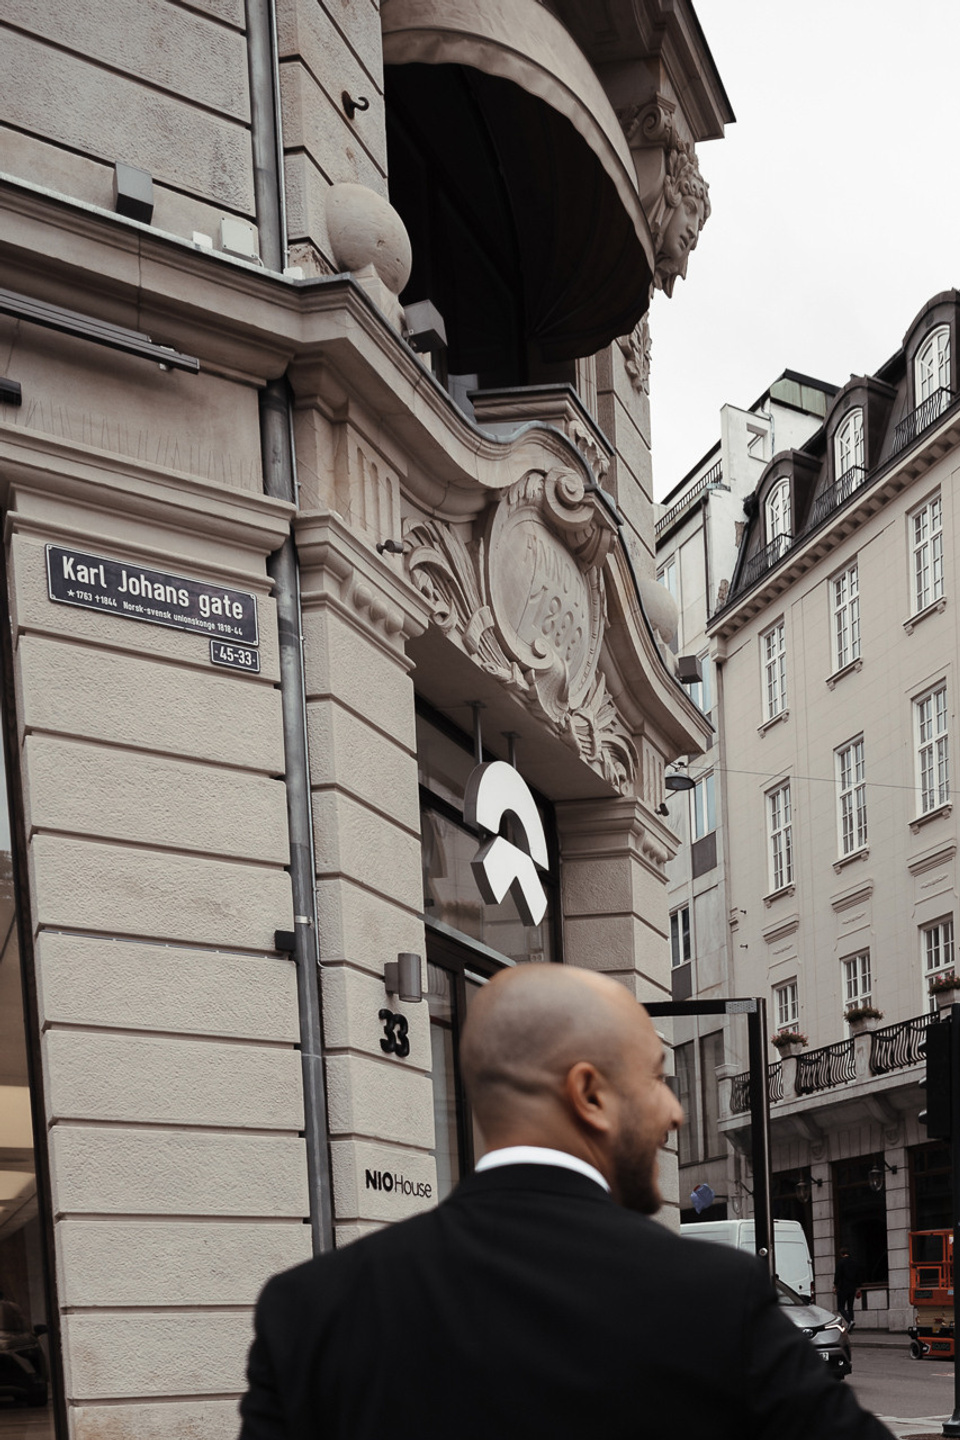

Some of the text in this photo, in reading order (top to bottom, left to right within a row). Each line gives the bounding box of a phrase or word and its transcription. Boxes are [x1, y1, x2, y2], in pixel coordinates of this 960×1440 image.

[62, 555, 243, 619] Karl Johans gate
[122, 601, 172, 619] Norsk-svensk
[173, 614, 216, 630] unionskonge
[217, 622, 243, 635] 1818-44
[219, 646, 252, 665] 45-33
[378, 1008, 410, 1058] 33
